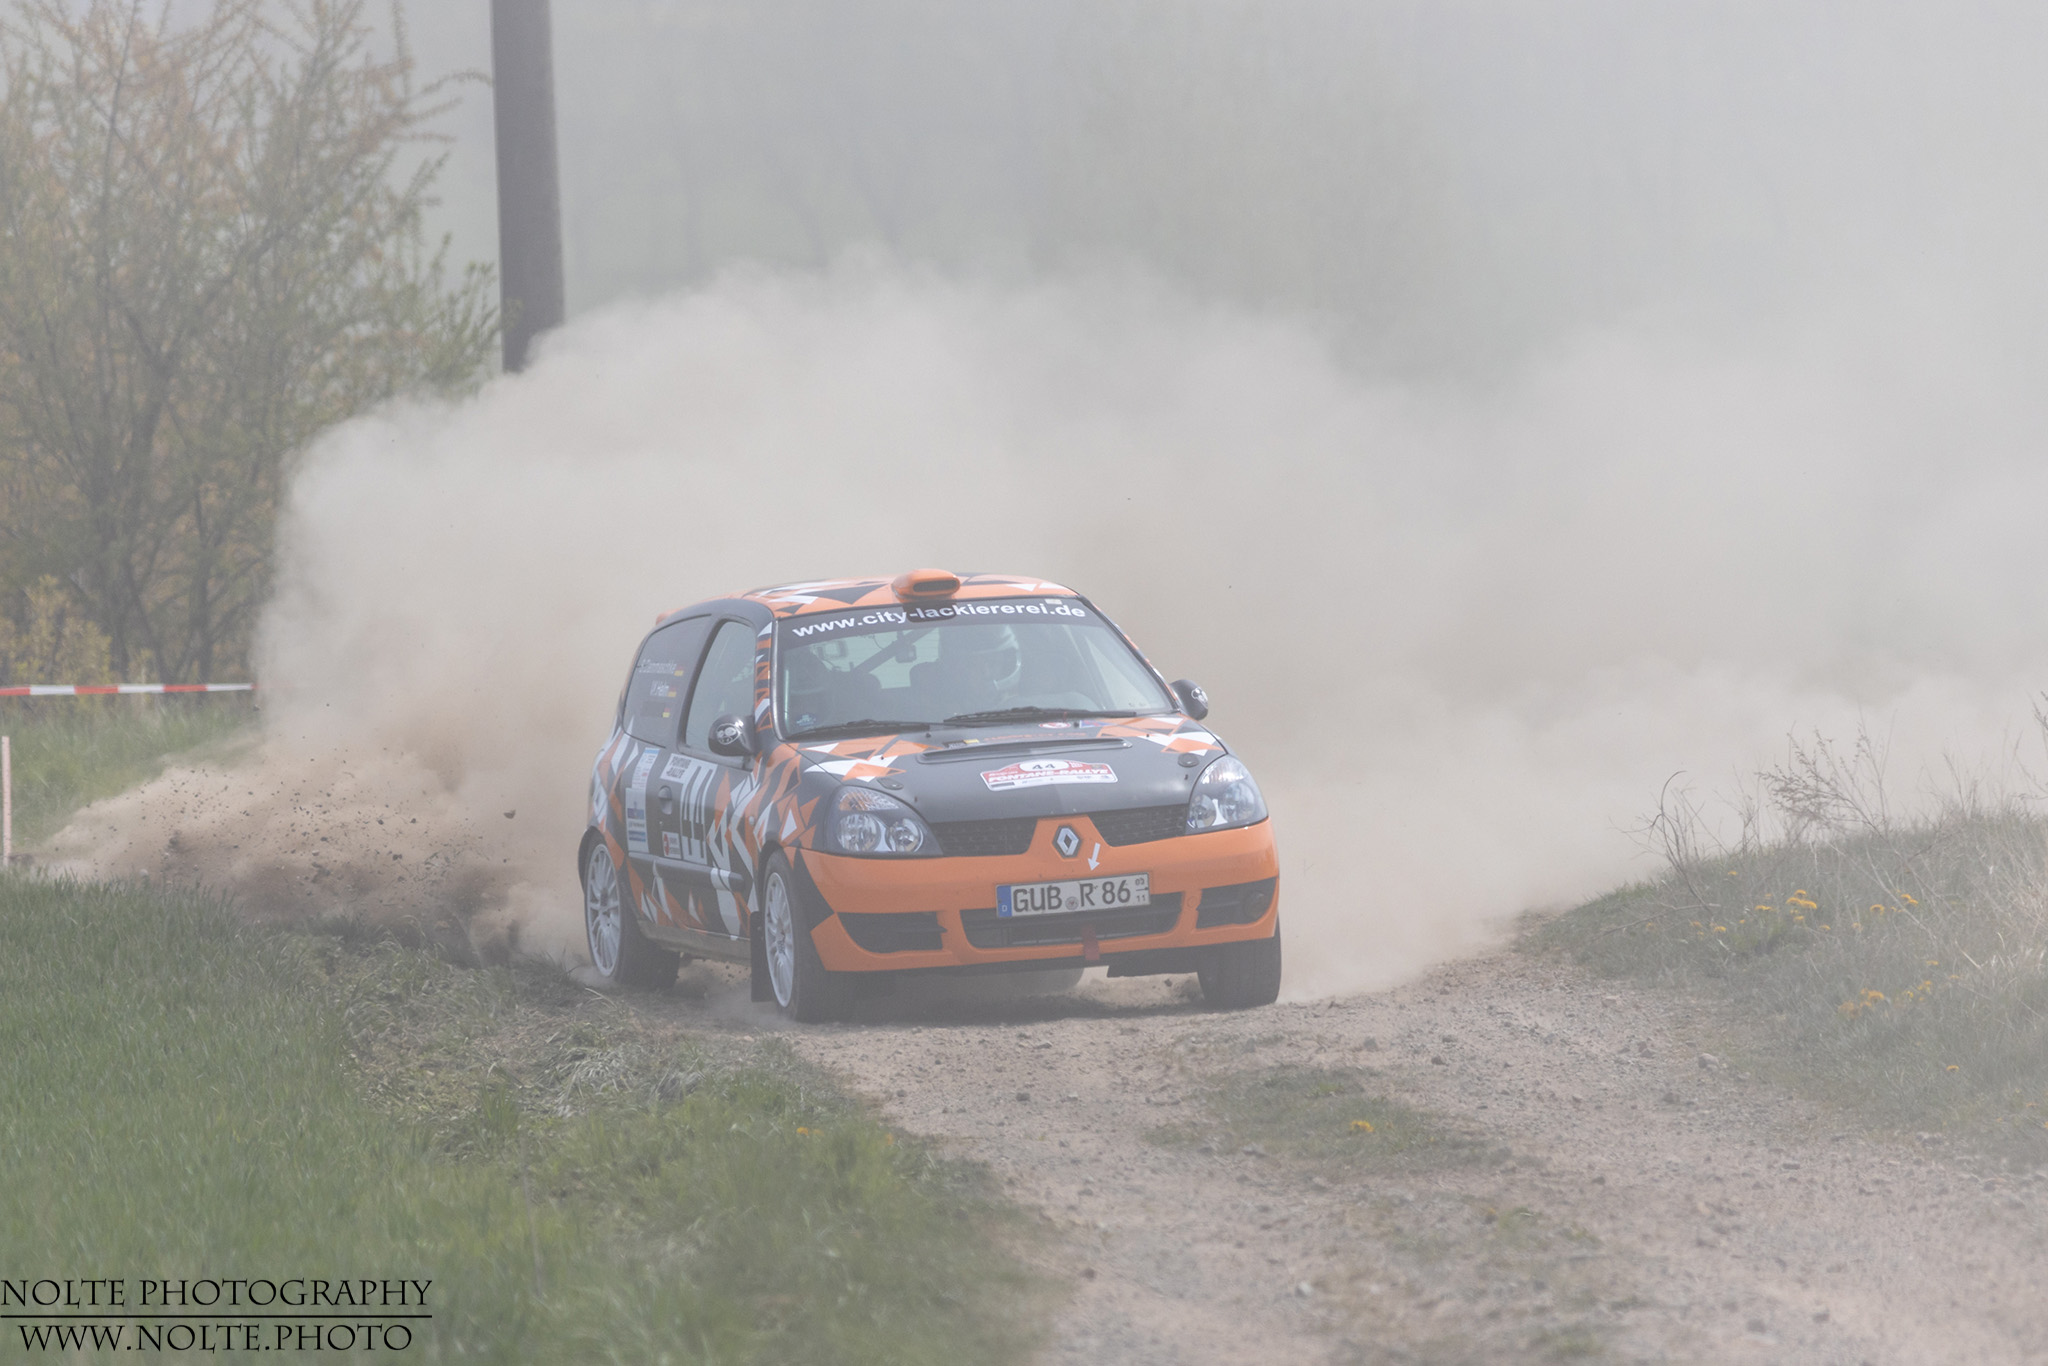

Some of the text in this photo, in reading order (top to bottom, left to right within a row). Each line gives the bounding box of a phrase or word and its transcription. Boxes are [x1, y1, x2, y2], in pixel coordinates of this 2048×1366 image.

[793, 602, 1086, 637] www.city-lackiererei.de
[1013, 880, 1131, 912] GUB R 86
